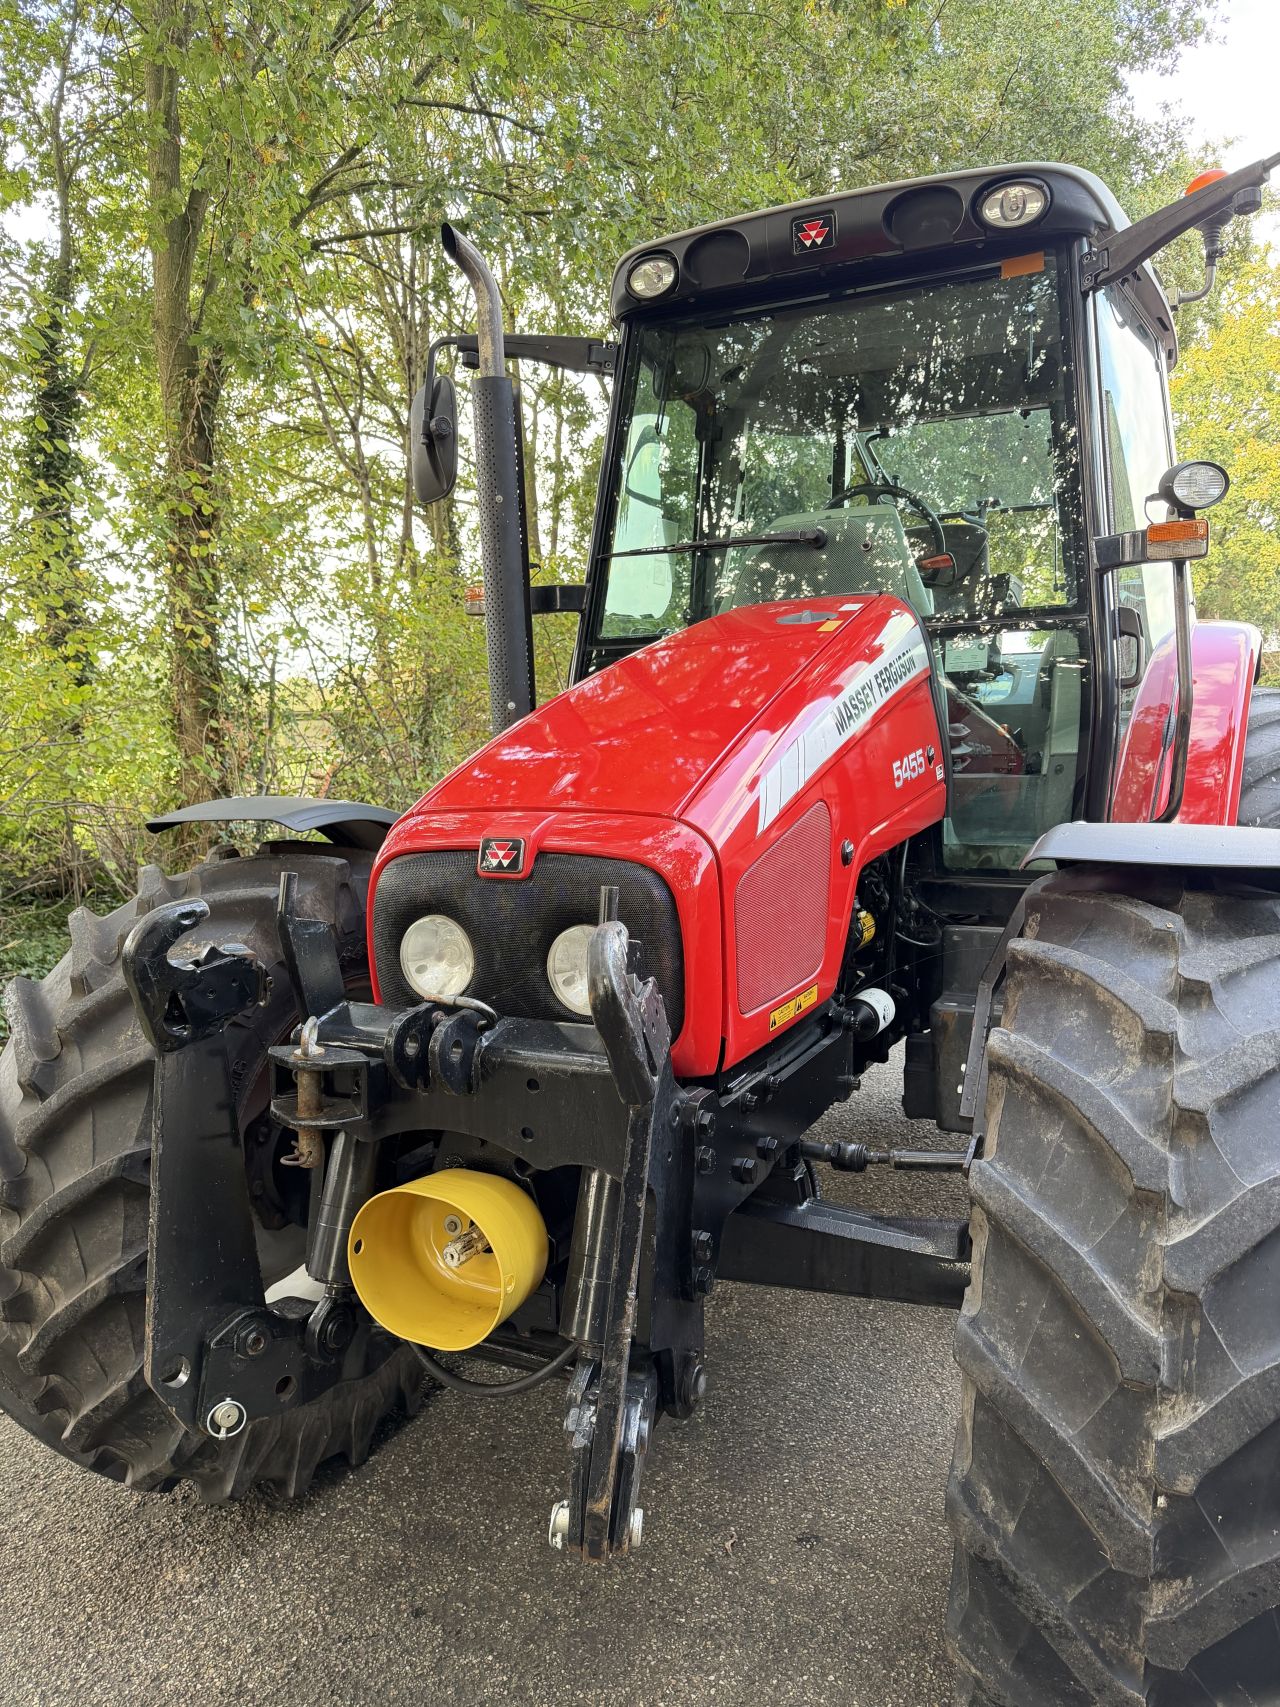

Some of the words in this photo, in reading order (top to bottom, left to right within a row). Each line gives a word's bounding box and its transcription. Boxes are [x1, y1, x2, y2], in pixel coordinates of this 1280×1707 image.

[832, 679, 877, 736] MASSEY
[873, 648, 917, 698] FERGUSON
[892, 748, 925, 789] 5455
